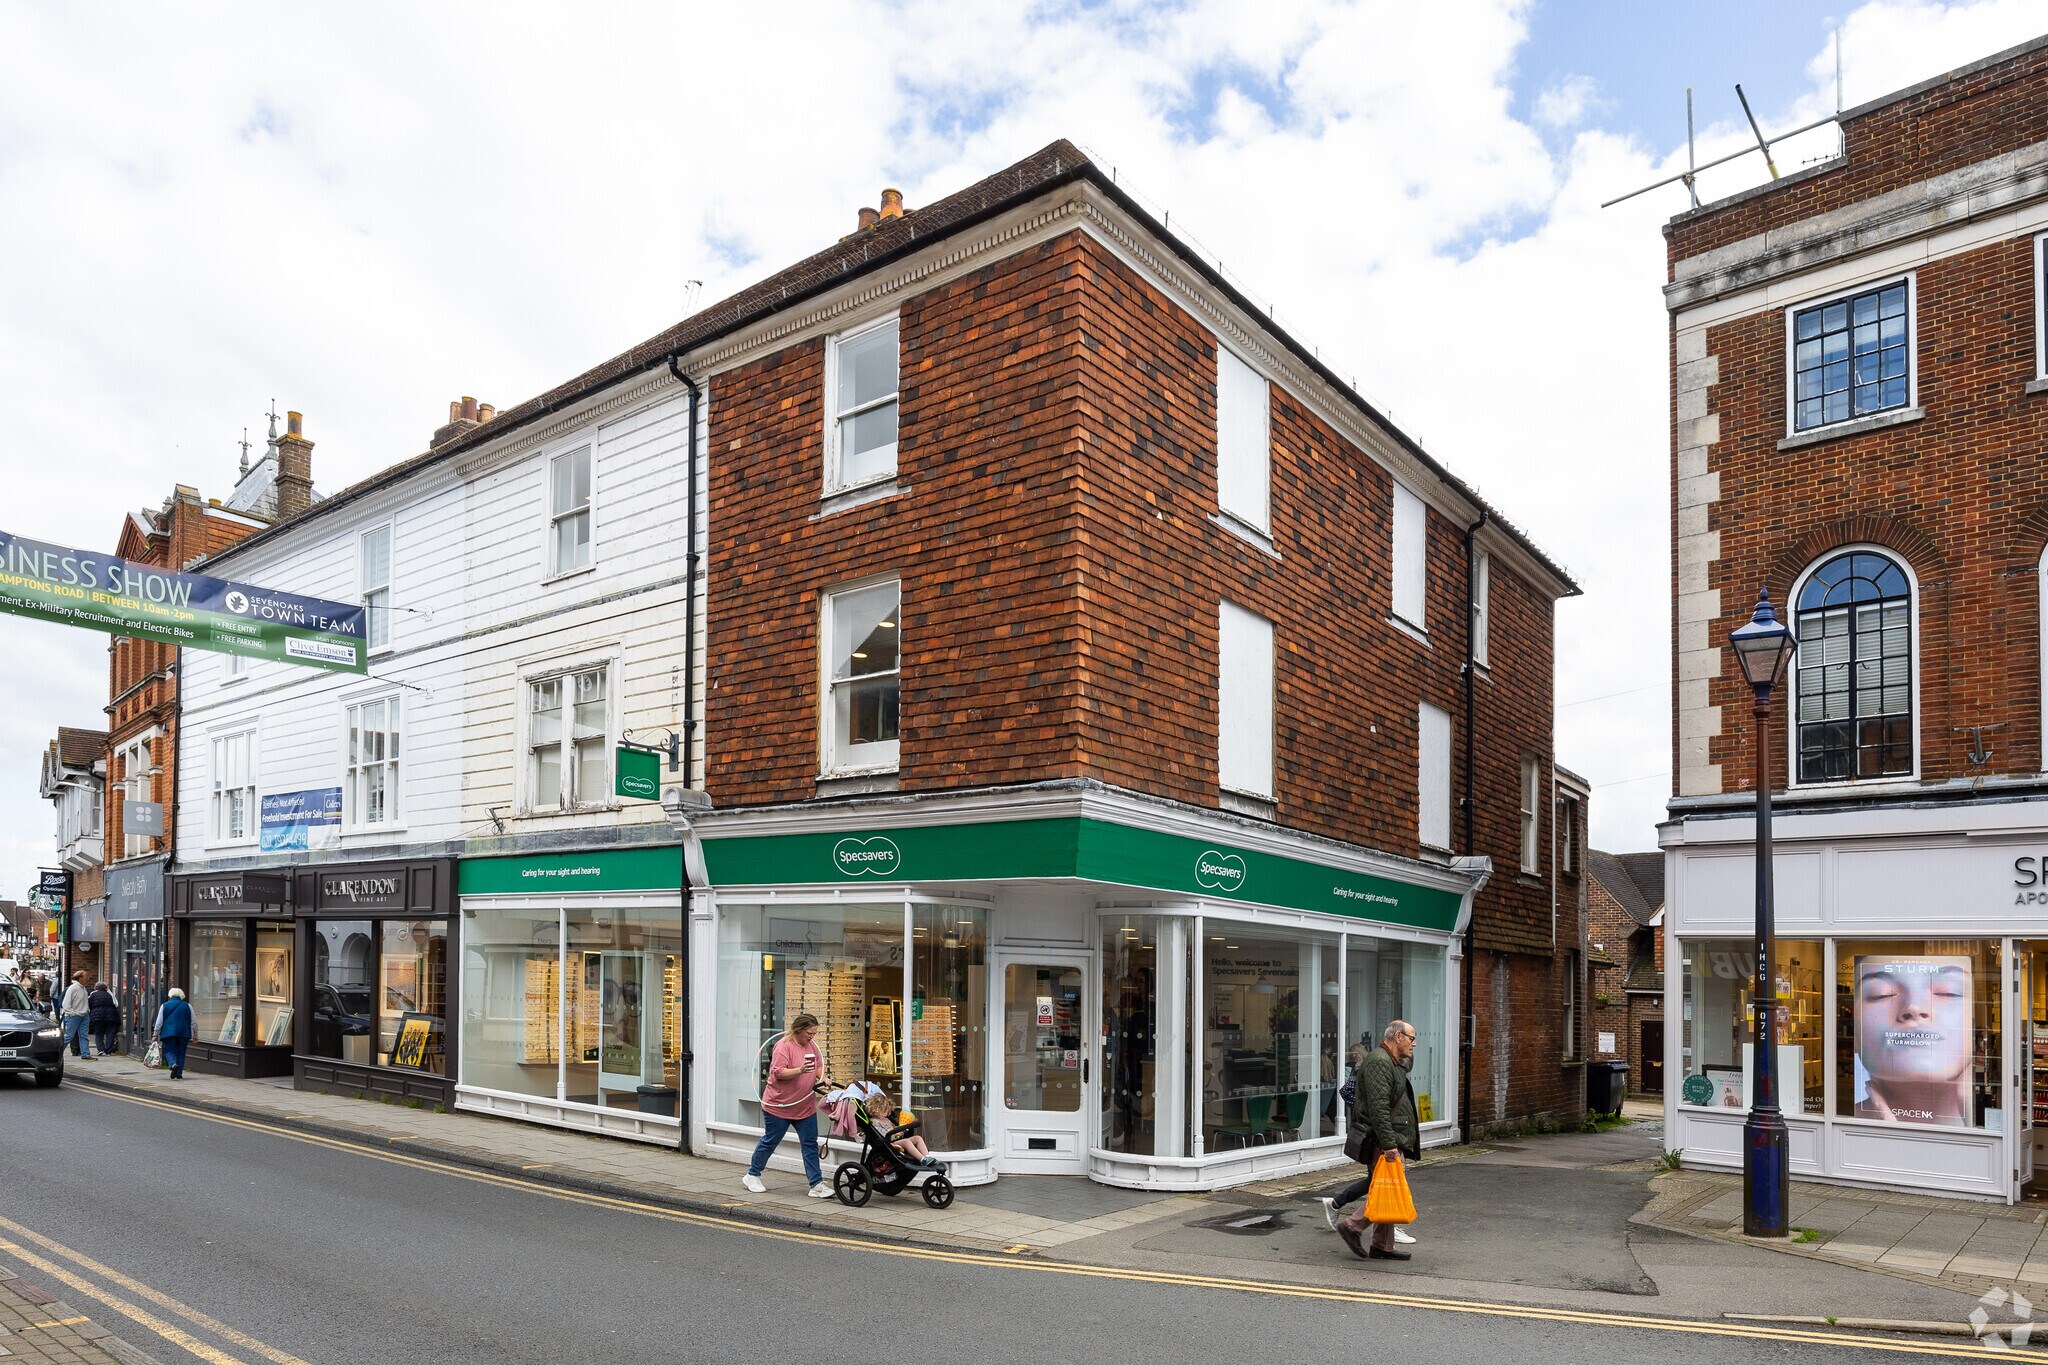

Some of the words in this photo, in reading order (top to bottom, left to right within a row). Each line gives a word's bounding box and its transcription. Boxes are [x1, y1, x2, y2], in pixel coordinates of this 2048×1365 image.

[107, 565, 193, 608] SHOW
[54, 585, 84, 600] ROAD
[92, 591, 140, 610] BETWEEN
[250, 596, 304, 612] SEVENOAKS
[25, 599, 73, 618] Ex-Military
[74, 608, 124, 626] Recruitment
[126, 618, 142, 629] and
[143, 621, 173, 635] Electric
[173, 627, 194, 639] Bikes
[251, 604, 305, 625] TOWN
[310, 614, 356, 634] TEAM
[221, 621, 237, 631] FREE
[237, 623, 257, 634] ENTRY
[220, 634, 236, 644] FREE
[236, 636, 263, 648] PARKING
[289, 640, 315, 651] Clive
[316, 644, 347, 657] Emson
[625, 780, 652, 790] Specsavers
[262, 813, 280, 822] Freehold
[305, 810, 313, 819] For
[313, 809, 323, 818] Sale
[839, 850, 894, 864] Specsavers
[522, 869, 537, 878] Caring
[537, 867, 545, 876] for
[545, 869, 557, 878] your
[557, 867, 570, 878] sight
[570, 867, 581, 875] and
[581, 866, 601, 876] hearing
[1200, 861, 1242, 879] Specsavers
[43, 874, 66, 886] Boots
[325, 878, 396, 902] CLARENDON
[1333, 886, 1347, 898] Caring
[1347, 888, 1355, 898] for
[1354, 891, 1365, 900] your
[1365, 892, 1375, 902] sight
[1375, 895, 1384, 903] and
[1383, 896, 1399, 907] hearing
[775, 939, 804, 949] Children
[1211, 958, 1233, 968] Hello,
[1235, 958, 1270, 967] welcome
[1884, 965, 1940, 973] STURM
[1212, 967, 1256, 976] Specsavers
[1884, 1031, 1940, 1039] SUPERCHARGED
